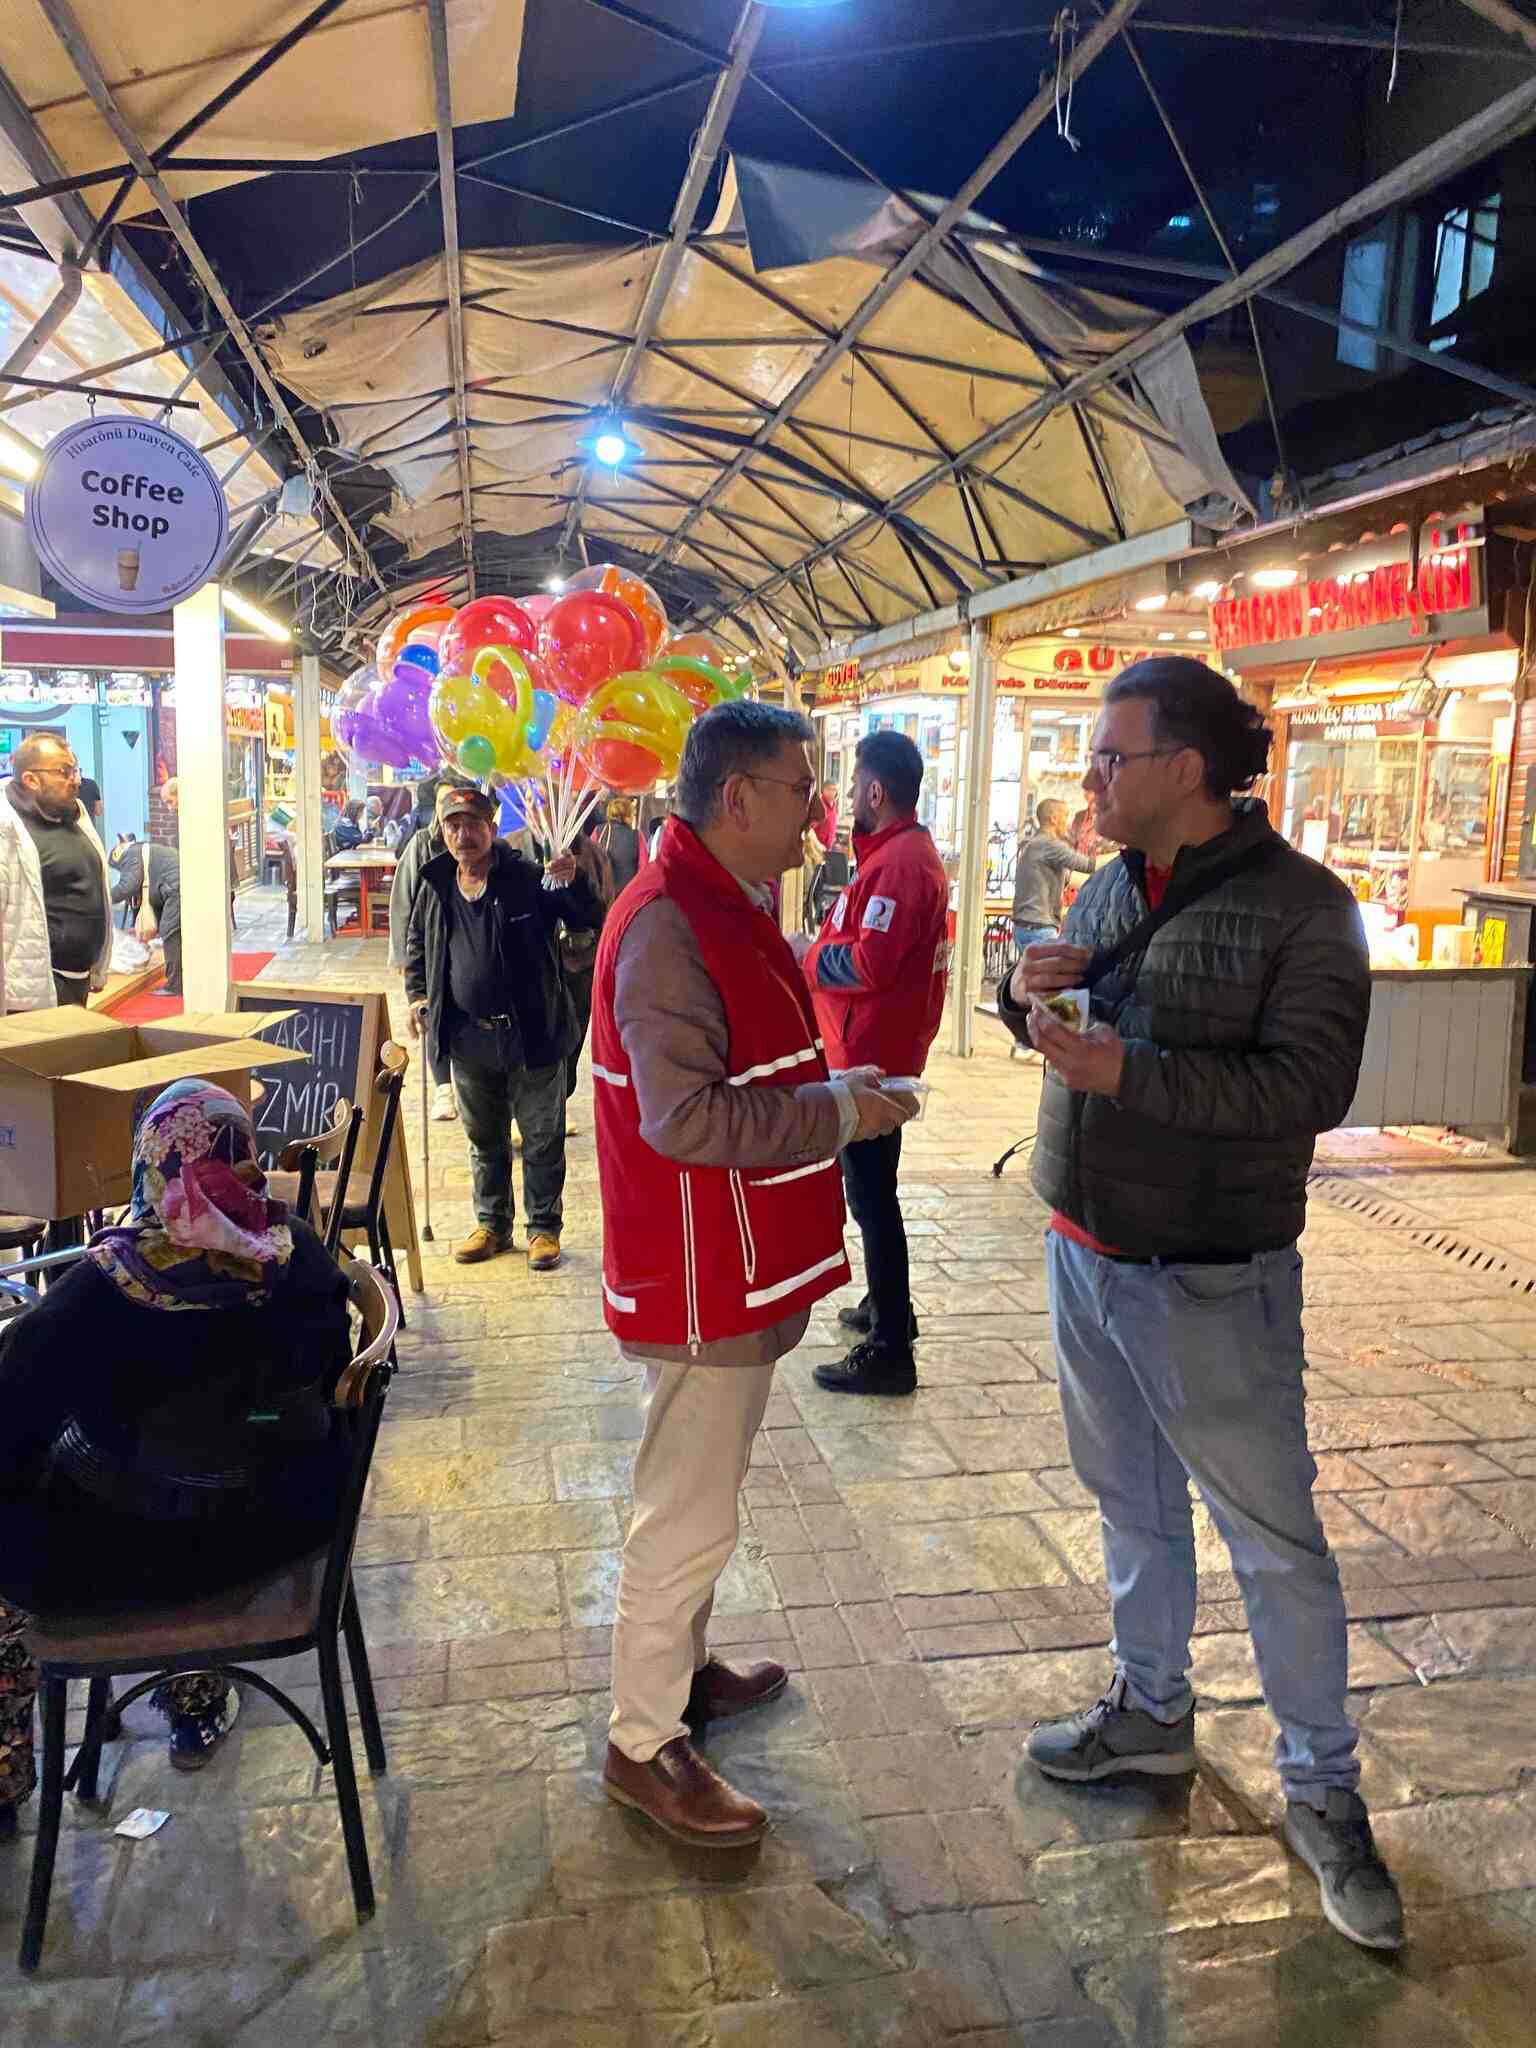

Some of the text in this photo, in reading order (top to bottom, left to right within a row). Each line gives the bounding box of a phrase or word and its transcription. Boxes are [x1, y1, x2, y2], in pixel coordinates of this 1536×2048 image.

[127, 426, 175, 454] Duayen
[81, 470, 184, 505] Coffee
[92, 504, 170, 540] Shop
[250, 1068, 339, 1137] ZMİR
